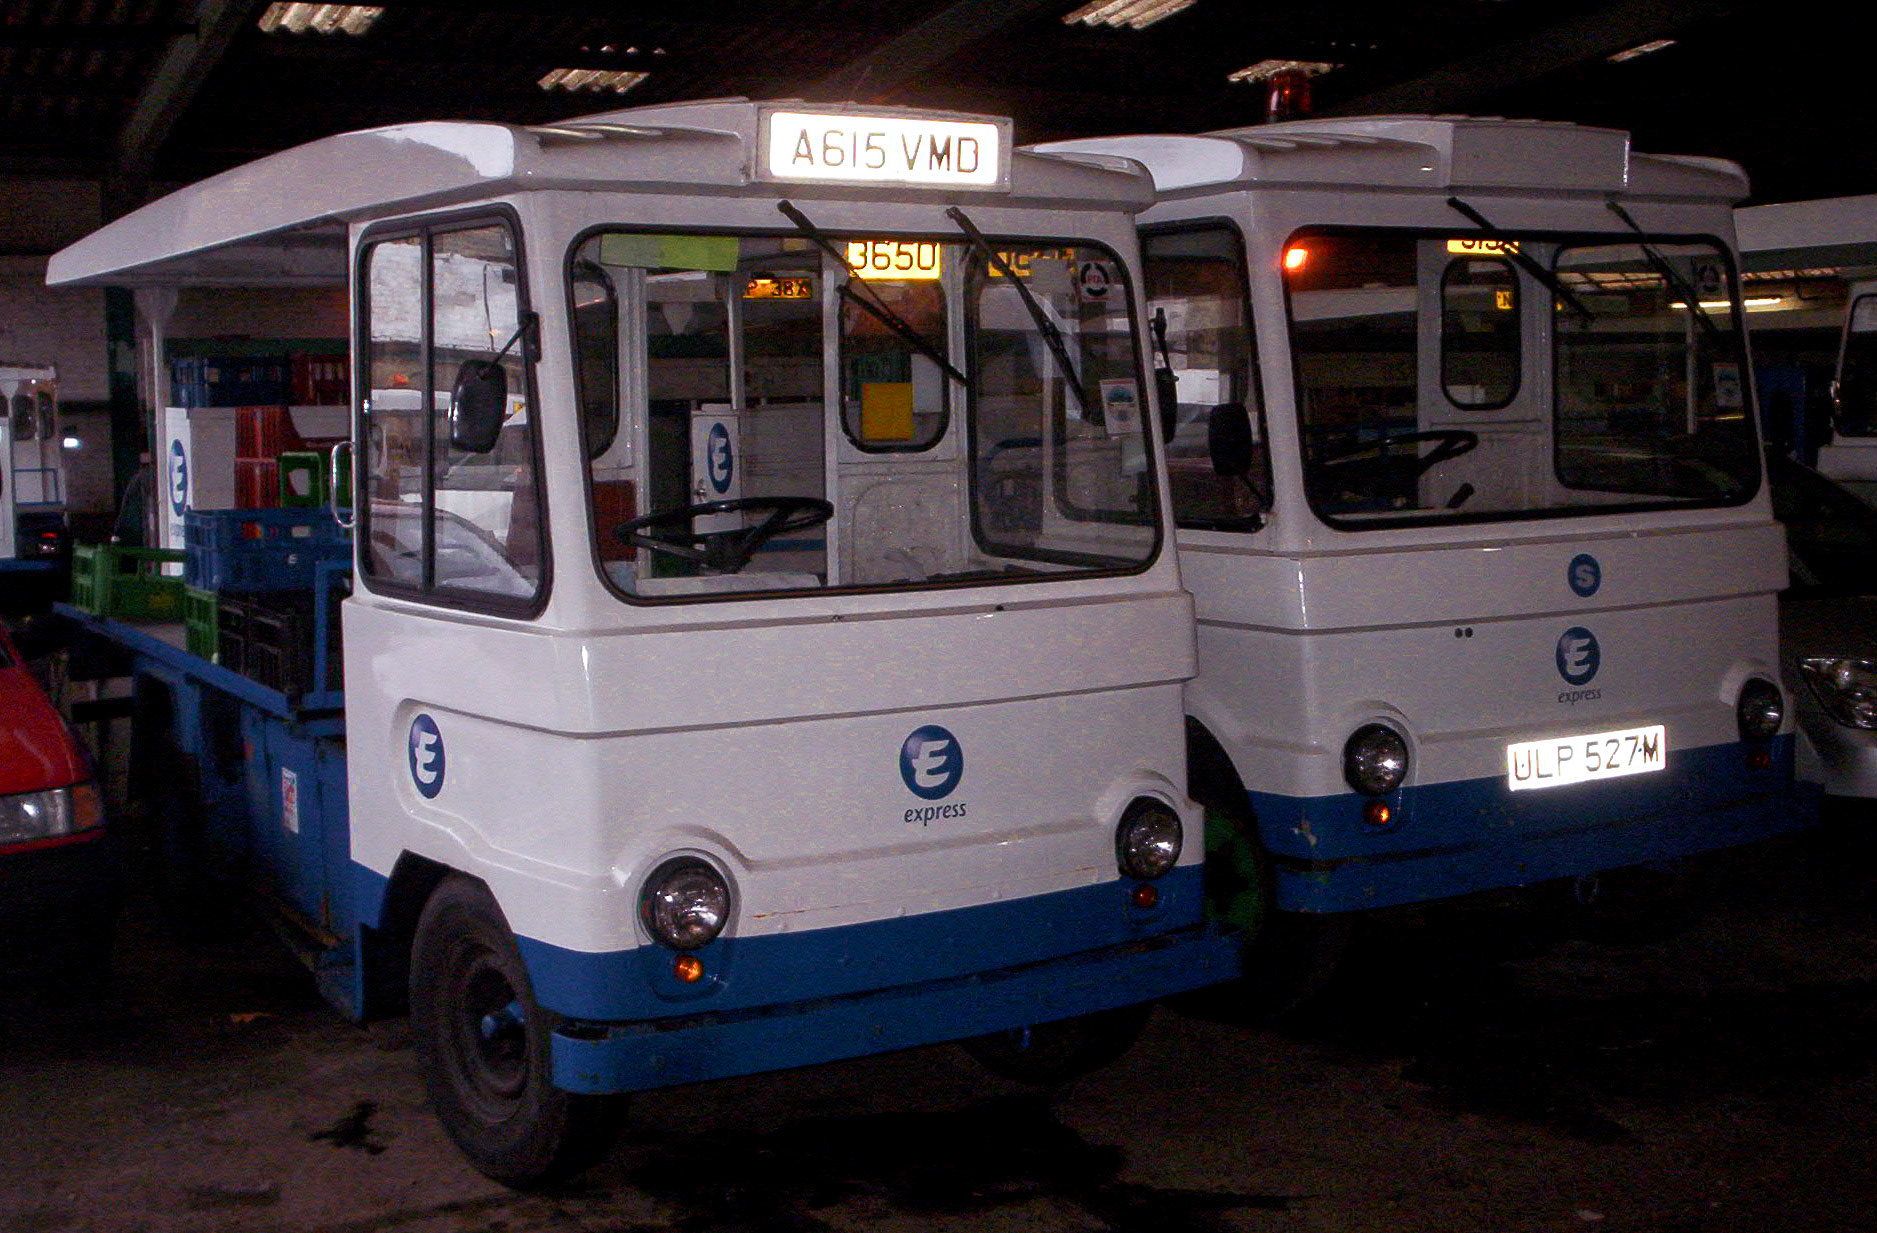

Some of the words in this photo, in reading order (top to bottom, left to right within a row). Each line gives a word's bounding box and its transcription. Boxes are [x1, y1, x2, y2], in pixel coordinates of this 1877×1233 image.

[793, 128, 885, 169] A615
[902, 134, 979, 173] VMD
[1558, 688, 1601, 706] express
[1514, 748, 1573, 781] ULP
[904, 803, 967, 826] express
